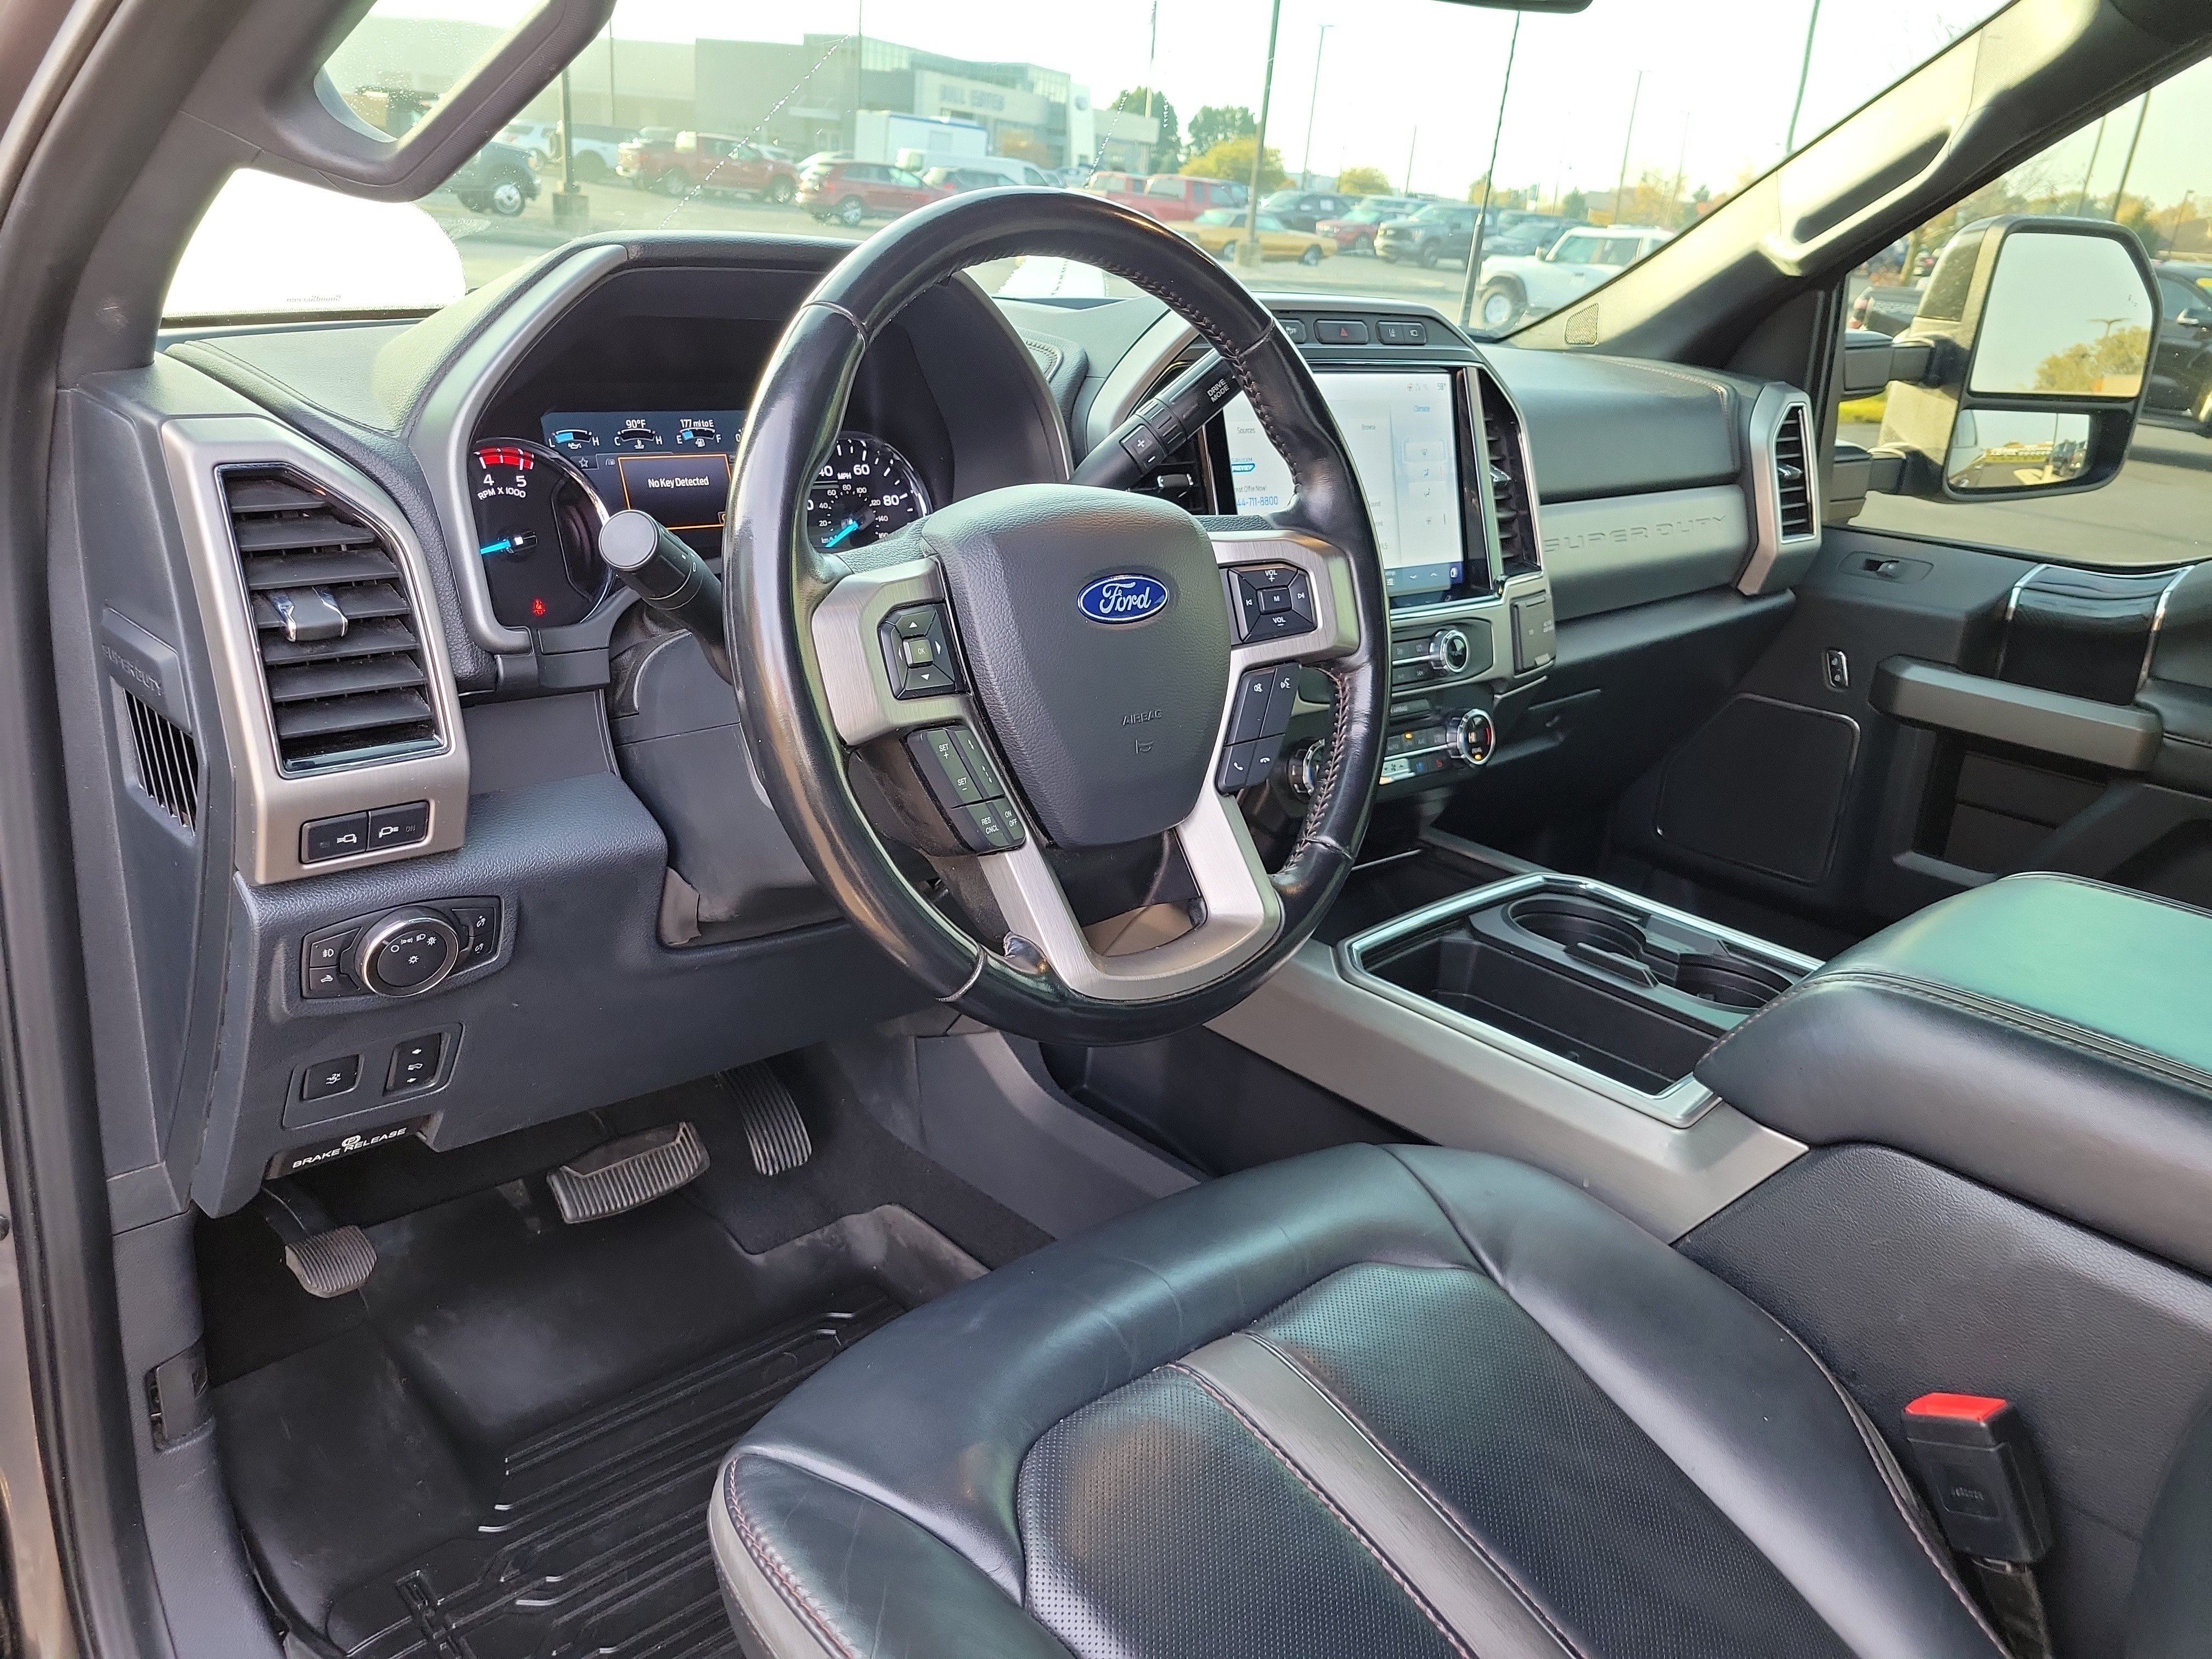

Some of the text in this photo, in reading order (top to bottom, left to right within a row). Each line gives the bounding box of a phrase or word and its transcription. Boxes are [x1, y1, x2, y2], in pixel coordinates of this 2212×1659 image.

[1206, 379, 1227, 397] DRIVE
[1211, 385, 1231, 403] MODE
[625, 419, 646, 428] 90°F
[680, 419, 692, 428] 177
[708, 419, 715, 427] E
[1237, 426, 1256, 435] Sources
[549, 436, 600, 448] L H
[614, 435, 663, 446] C H
[676, 434, 722, 444] E F
[853, 464, 870, 475] 60
[483, 474, 527, 488] 4 5
[647, 475, 709, 489] No Key Detected
[837, 472, 852, 480] MPH
[477, 487, 527, 500] RPM X 1000
[883, 494, 900, 506] 80
[1543, 515, 1727, 553] SUPER DUTY
[1099, 581, 1152, 614] Ford
[1121, 709, 1163, 726] AIRBAG
[939, 743, 949, 752] SET
[957, 777, 967, 786] SET
[981, 810, 1013, 826] RES ON
[985, 818, 1018, 834] CNCL OFF
[292, 1127, 408, 1169] BRAKE RELEASE
